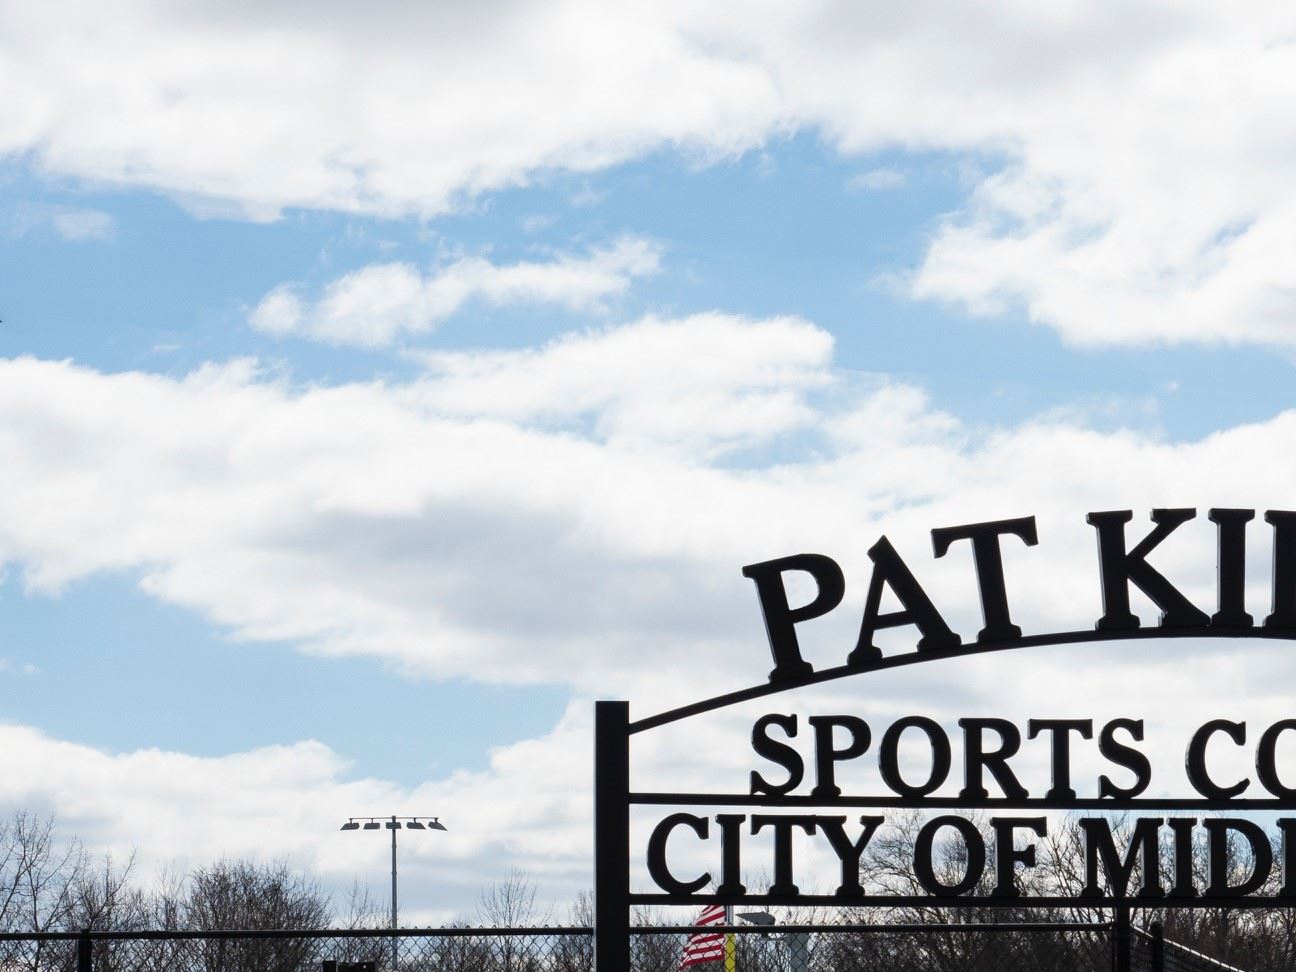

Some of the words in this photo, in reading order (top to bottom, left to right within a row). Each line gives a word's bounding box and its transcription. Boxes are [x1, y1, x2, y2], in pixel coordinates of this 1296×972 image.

[742, 515, 1039, 688] PAT
[750, 713, 1153, 800] SPORTS
[647, 812, 885, 896] CITY
[912, 814, 1048, 898] OF
